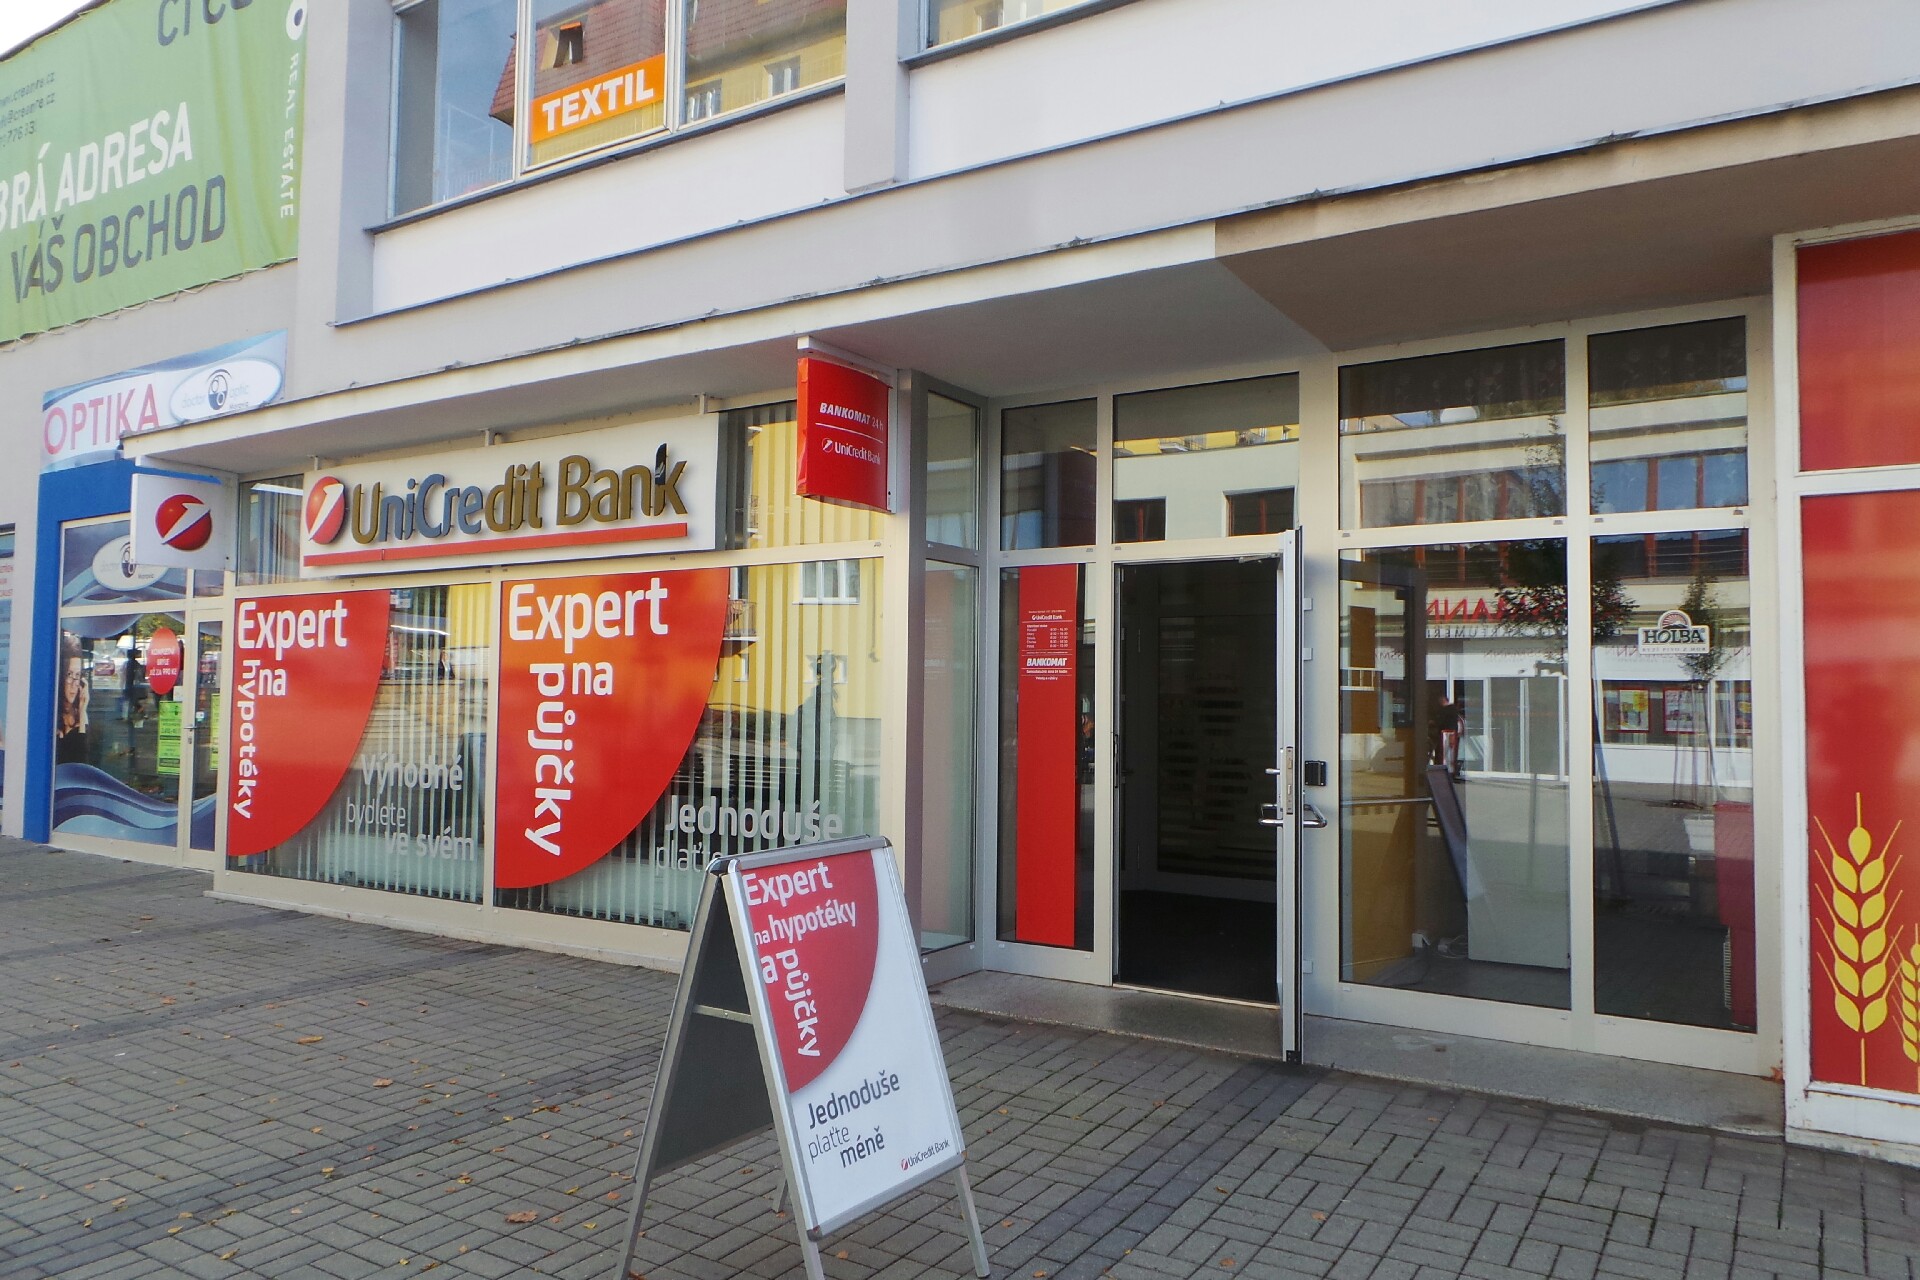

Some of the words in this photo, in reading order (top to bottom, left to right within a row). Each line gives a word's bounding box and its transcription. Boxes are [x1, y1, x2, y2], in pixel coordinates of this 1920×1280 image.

[285, 52, 299, 119] REAL
[542, 69, 654, 132] TEXTIL
[54, 101, 193, 213] ADRESA
[280, 126, 294, 219] ESTATE
[10, 213, 65, 304] VÁŠ
[72, 174, 226, 284] OBCHOD
[44, 383, 160, 455] OPTIKA
[820, 402, 871, 425] BANKOMAT
[835, 442, 868, 461] UniCredit
[868, 450, 880, 465] Bank
[351, 460, 545, 544] UniCredit
[556, 443, 688, 526] Bank
[238, 599, 348, 660] Expert
[508, 577, 668, 654] Expert
[1643, 629, 1704, 643] HOLBA
[258, 667, 286, 696] na
[571, 661, 613, 696] na
[1027, 657, 1067, 667] BANKOMAT
[233, 659, 260, 819] hypotéky
[524, 663, 576, 857] půjčky
[361, 752, 463, 794] Výhodné
[346, 797, 406, 830] bydlete
[665, 795, 842, 842] Jednoduše
[385, 831, 408, 855] ve
[416, 826, 473, 861] svém
[742, 861, 833, 907] Expert
[753, 929, 771, 946] na
[768, 899, 856, 944] hypotéky
[760, 954, 778, 984] a
[776, 948, 821, 1057] půjčky
[808, 1069, 900, 1129] Jednoduše
[808, 1125, 851, 1165] plaťte
[840, 1125, 885, 1169] méně
[908, 1145, 935, 1167] UniCredit
[935, 1139, 950, 1153] Bank
